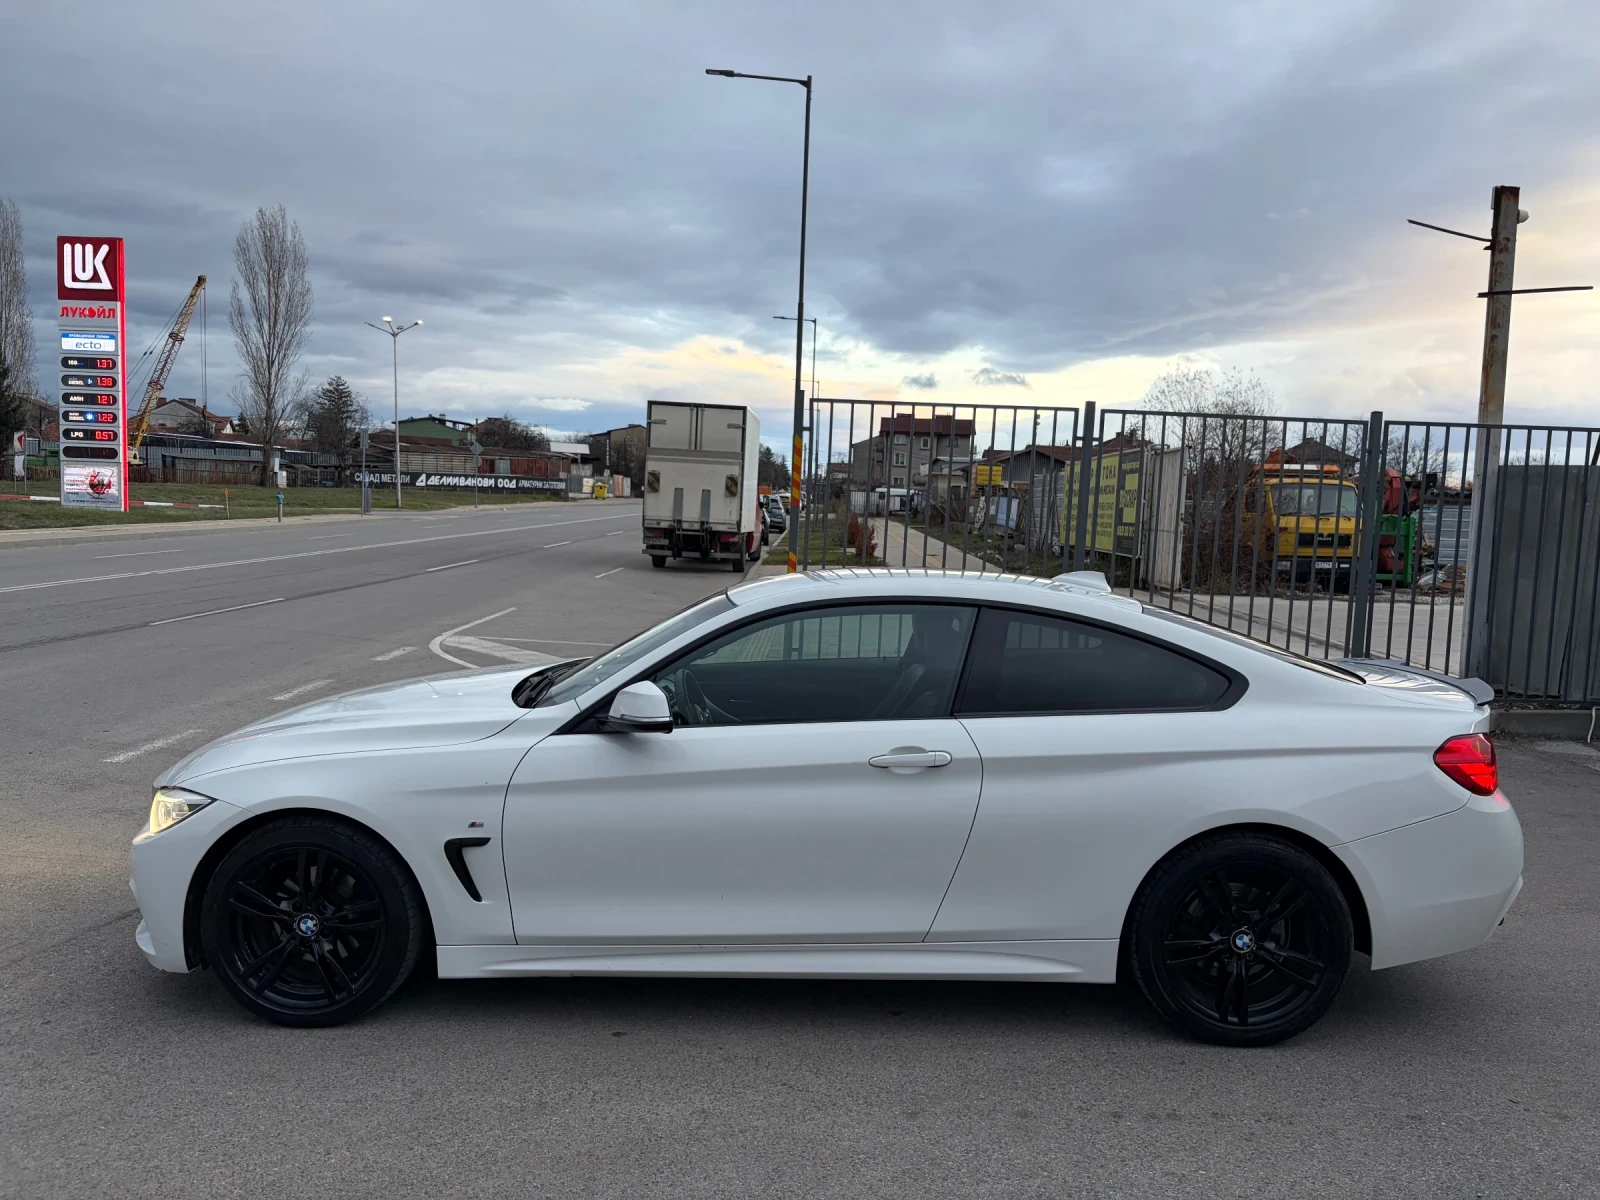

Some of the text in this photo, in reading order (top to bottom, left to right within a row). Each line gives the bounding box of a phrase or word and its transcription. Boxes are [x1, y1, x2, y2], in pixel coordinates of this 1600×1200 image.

[75, 341, 102, 349] ecto
[97, 359, 113, 368] 1.37
[97, 377, 113, 386] 1.38
[97, 395, 113, 404] 1.21
[98, 413, 113, 422] 1.22
[95, 431, 114, 440] 0.57
[354, 472, 380, 483] САД
[497, 478, 517, 489] ООД
